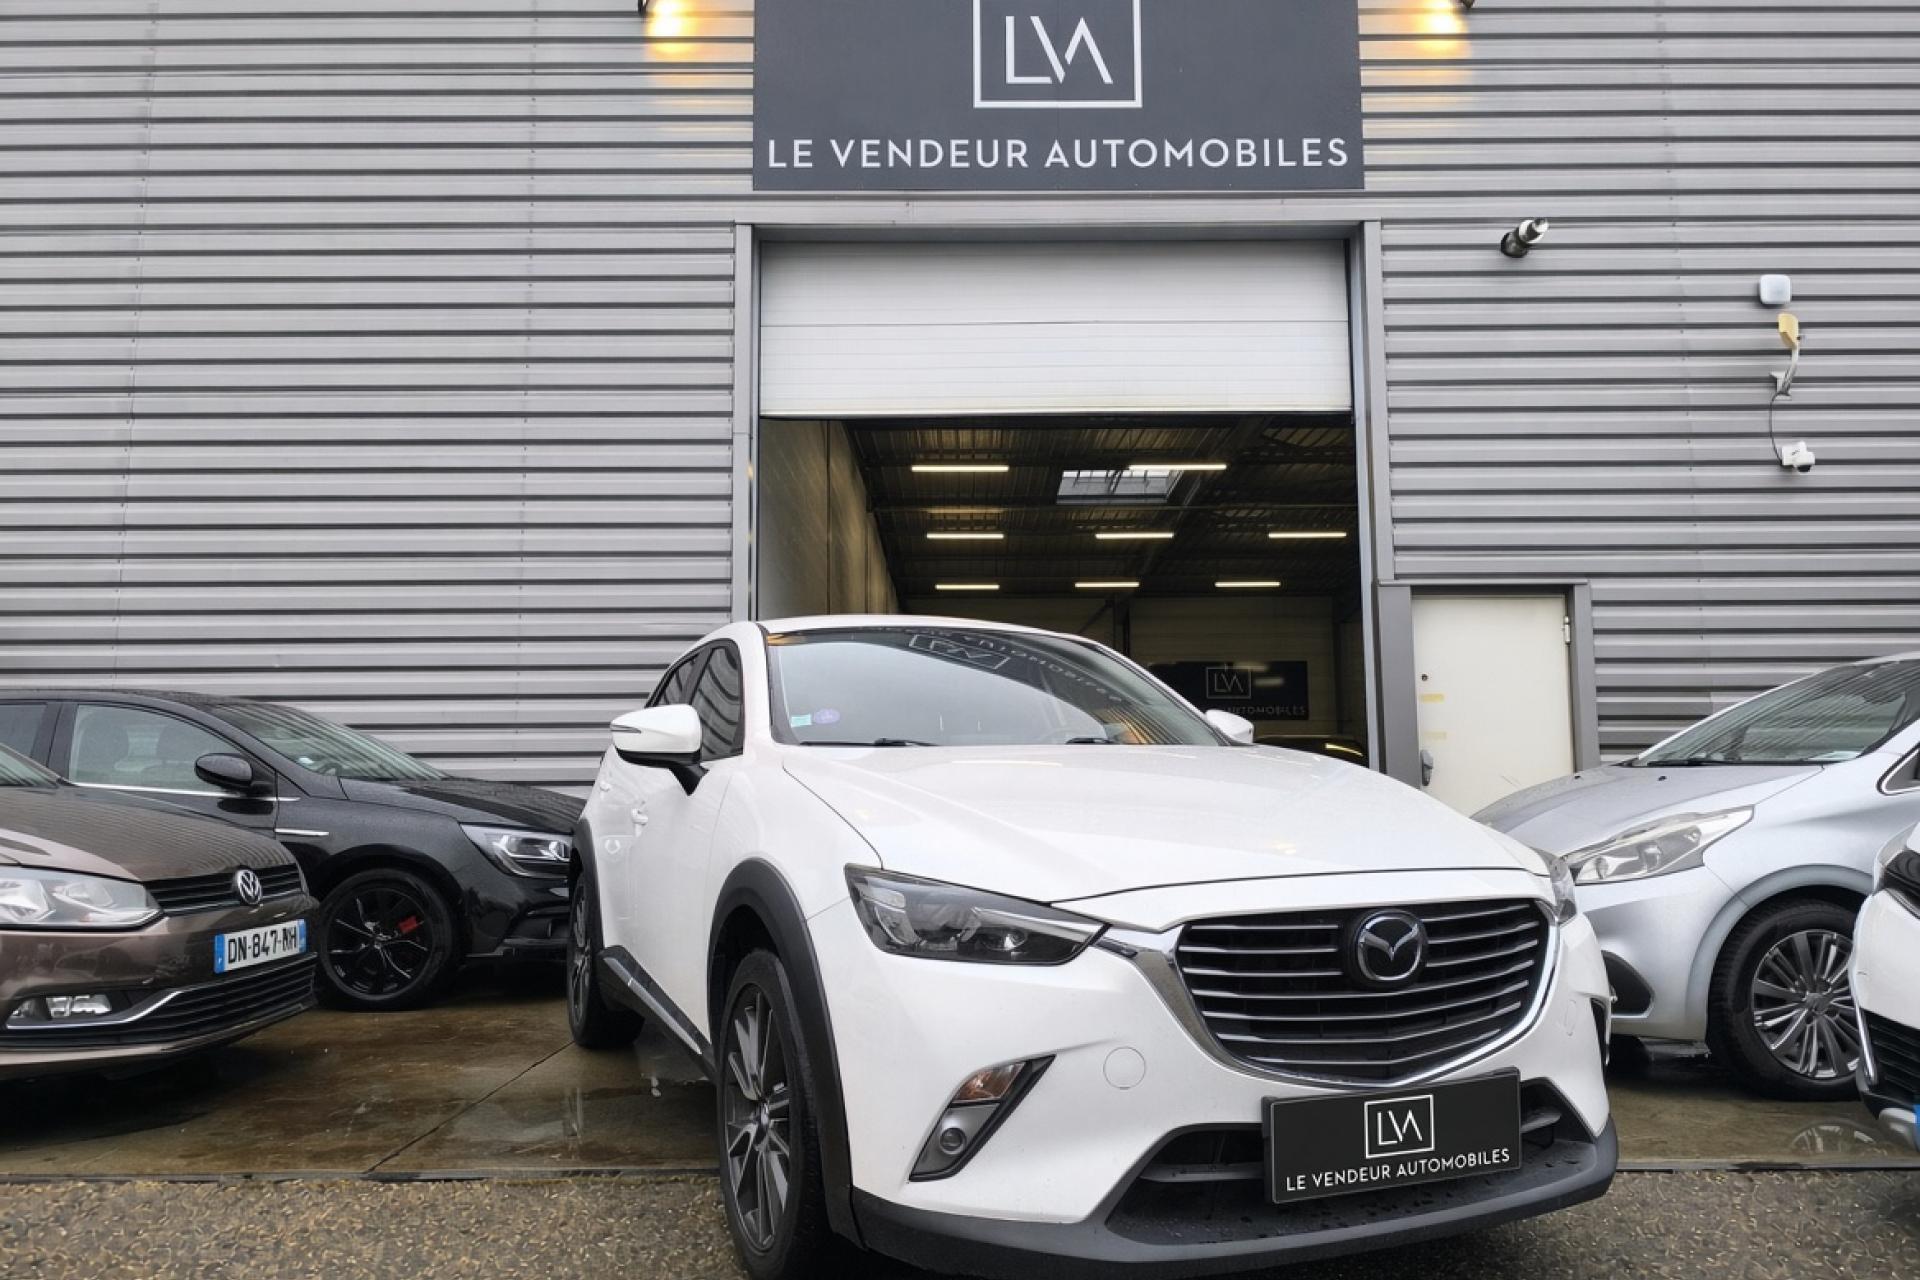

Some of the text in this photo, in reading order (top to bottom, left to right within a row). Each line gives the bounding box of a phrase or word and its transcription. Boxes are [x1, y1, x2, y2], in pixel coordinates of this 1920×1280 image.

[768, 138, 1349, 167] LE VENDEUR AUTOMOBILES
[1286, 1148, 1510, 1191] LE VENDEUR AUTOMOBILES
